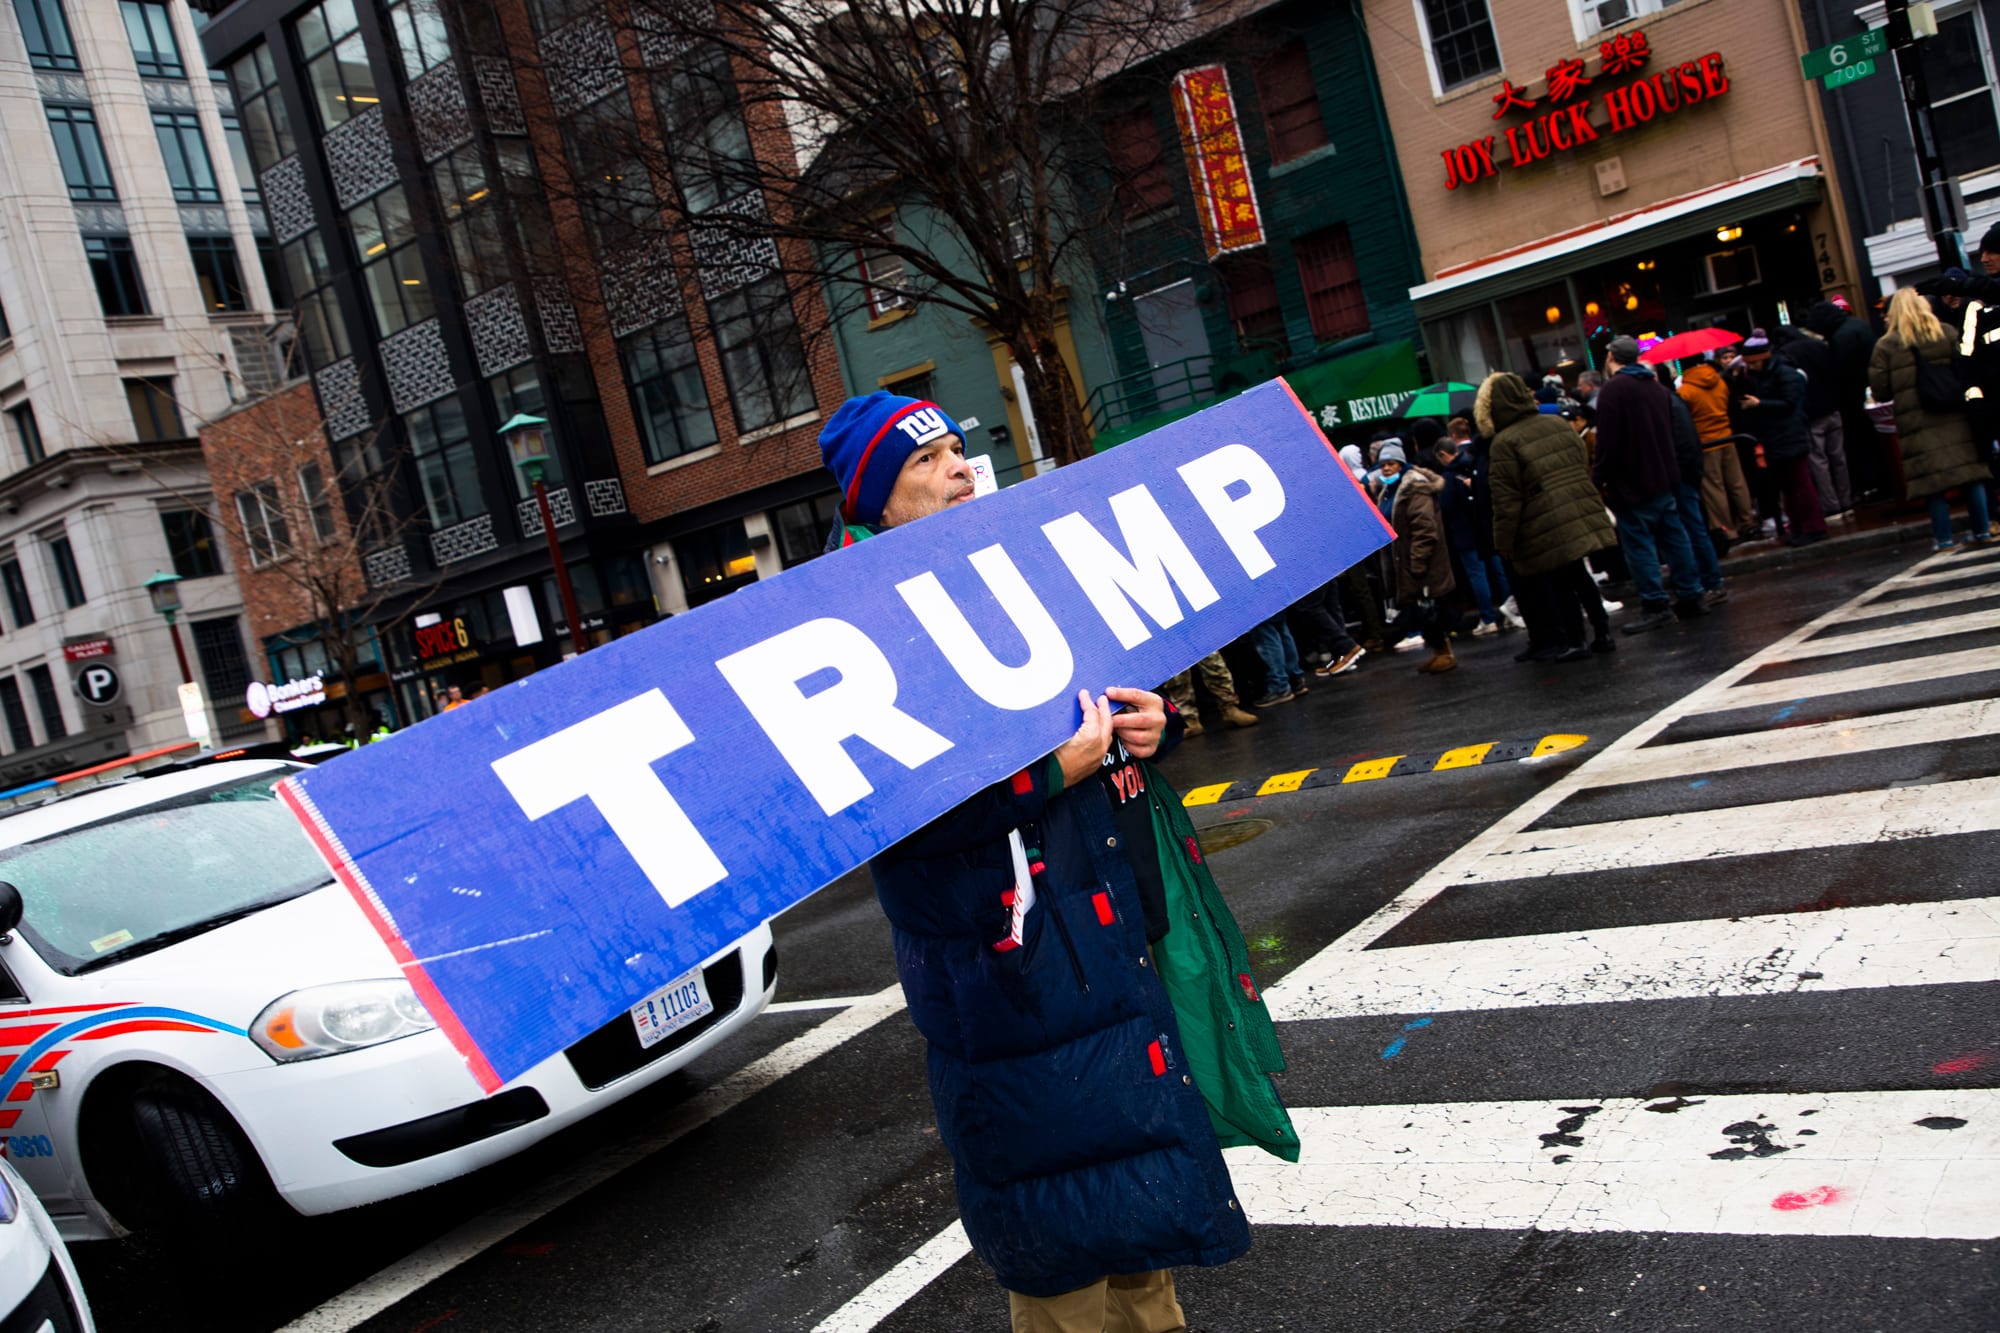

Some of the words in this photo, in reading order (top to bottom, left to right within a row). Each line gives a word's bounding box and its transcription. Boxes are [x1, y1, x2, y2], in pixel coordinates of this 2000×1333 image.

[1830, 45, 1848, 66] 6
[1862, 32, 1876, 45] ST
[1864, 44, 1880, 55] NW
[1492, 30, 1650, 121] 大家樂
[1832, 60, 1868, 83] 700
[1441, 135, 1497, 190] JOY
[1503, 100, 1599, 168] LUCK
[1603, 51, 1729, 133] HOUSE
[1815, 231, 1837, 284] 748
[415, 621, 459, 658] SPICE
[454, 617, 469, 648] 6
[86, 668, 113, 699] P
[490, 443, 1287, 909] TRUMP
[660, 981, 700, 1021] 11103
[8, 1134, 54, 1158] 9810
